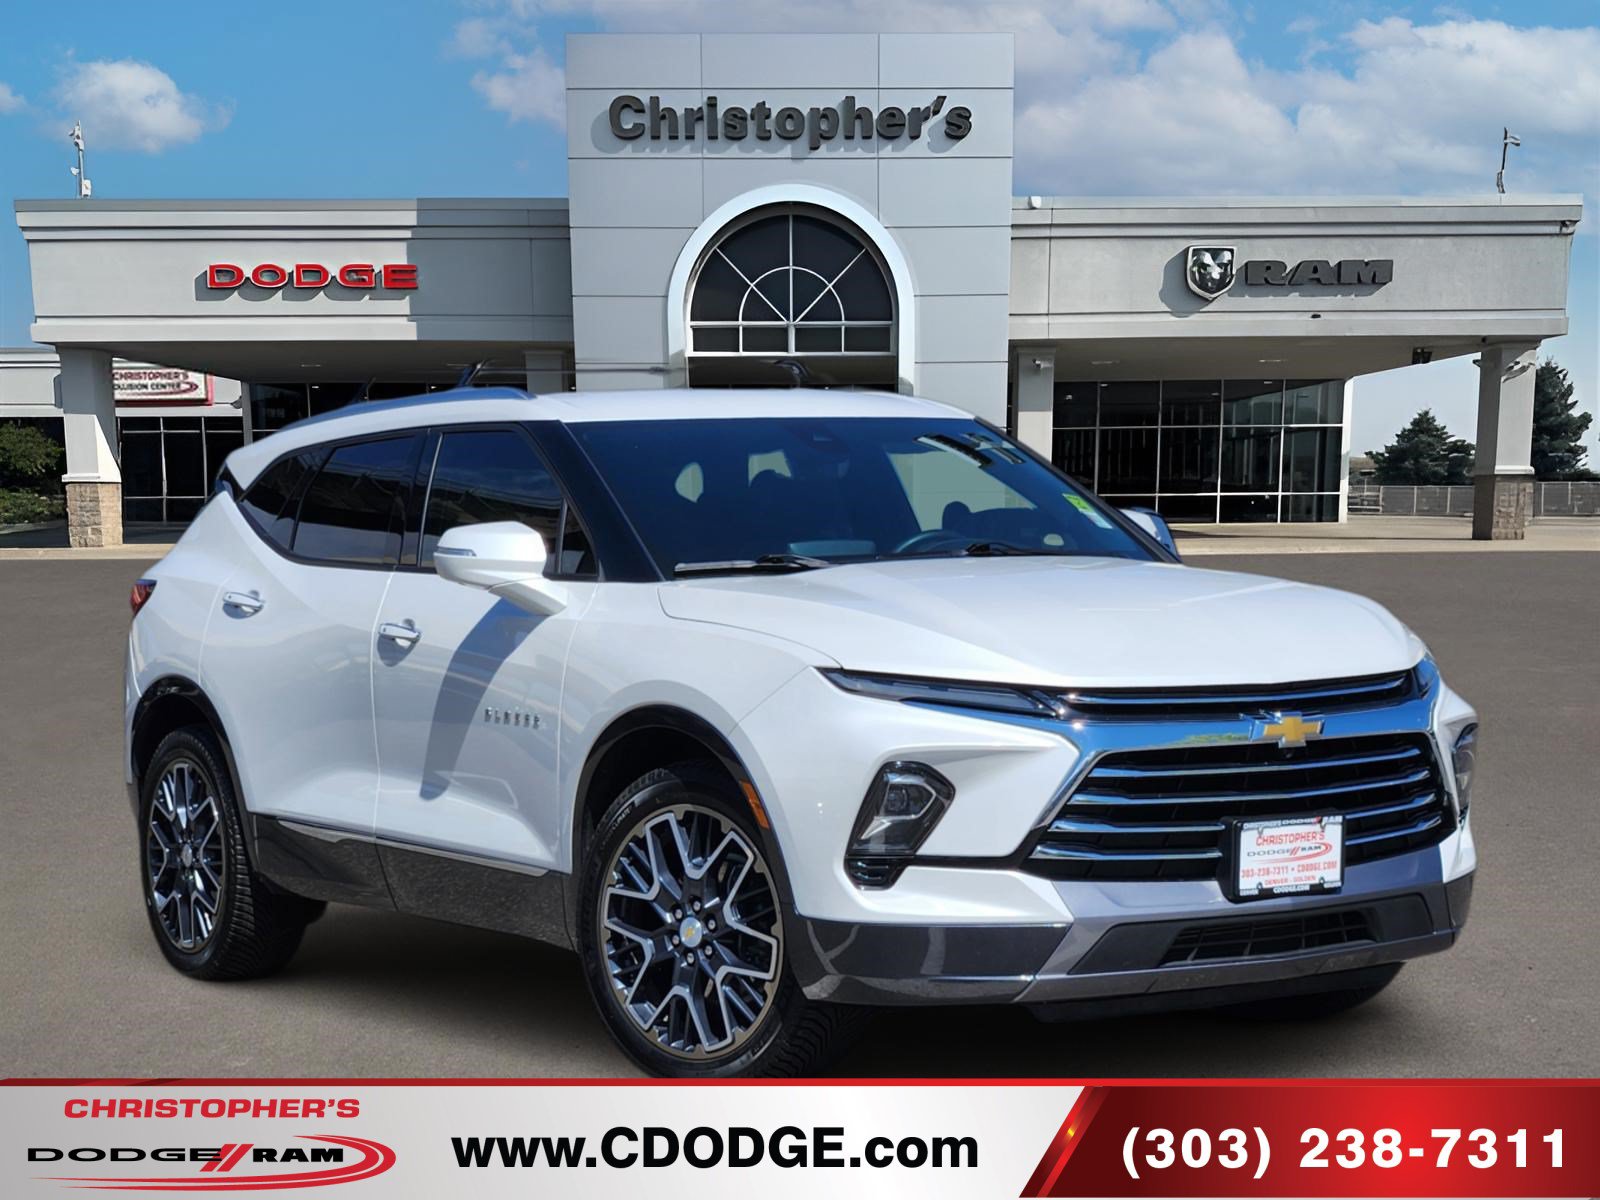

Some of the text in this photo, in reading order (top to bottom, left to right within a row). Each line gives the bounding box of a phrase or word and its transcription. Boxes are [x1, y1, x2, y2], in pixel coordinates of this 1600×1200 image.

[609, 95, 972, 150] Christopher's
[207, 263, 418, 288] DODGE
[1245, 259, 1394, 285] RAM
[113, 371, 189, 381] CHRISTOPHER'S
[112, 382, 181, 391] OLLISION CENTER
[1256, 831, 1325, 846] CHRISTOPHER'S
